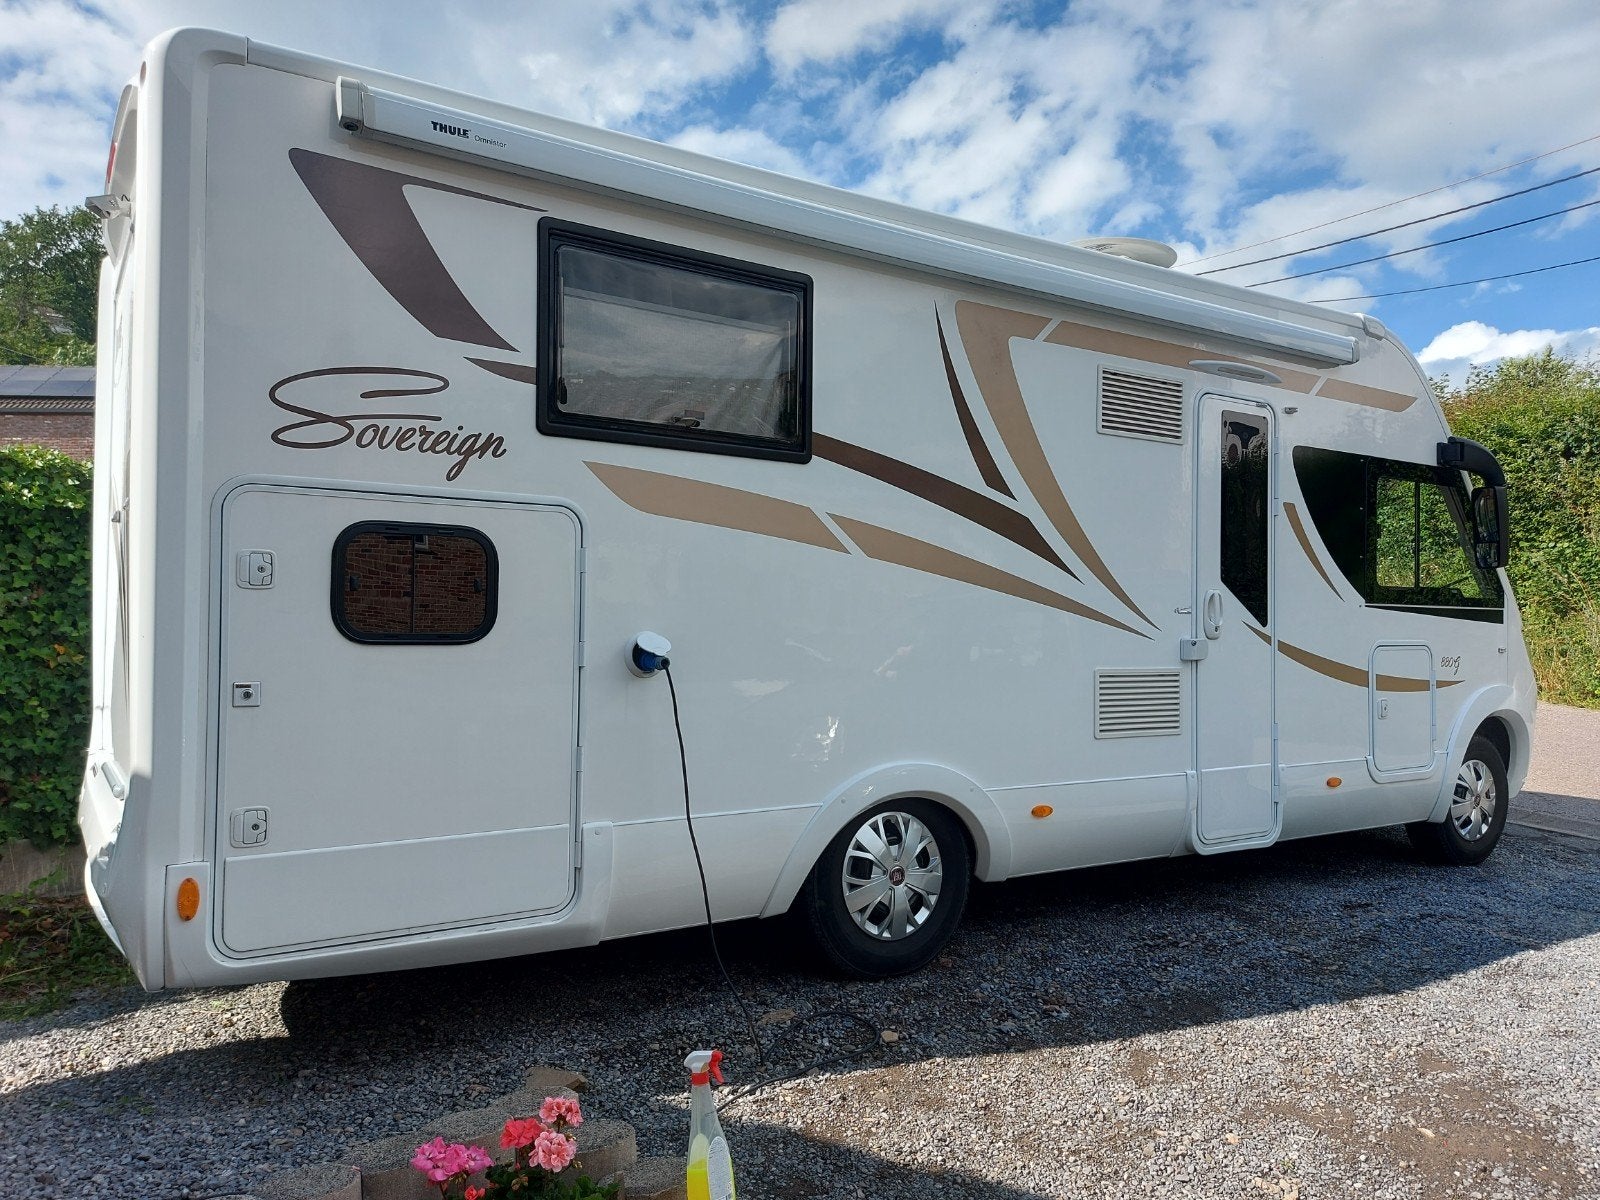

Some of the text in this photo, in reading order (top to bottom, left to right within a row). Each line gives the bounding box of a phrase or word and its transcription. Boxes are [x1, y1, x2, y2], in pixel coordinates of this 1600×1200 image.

[430, 120, 507, 148] THULE Omnistor
[268, 366, 507, 482] Sovereign
